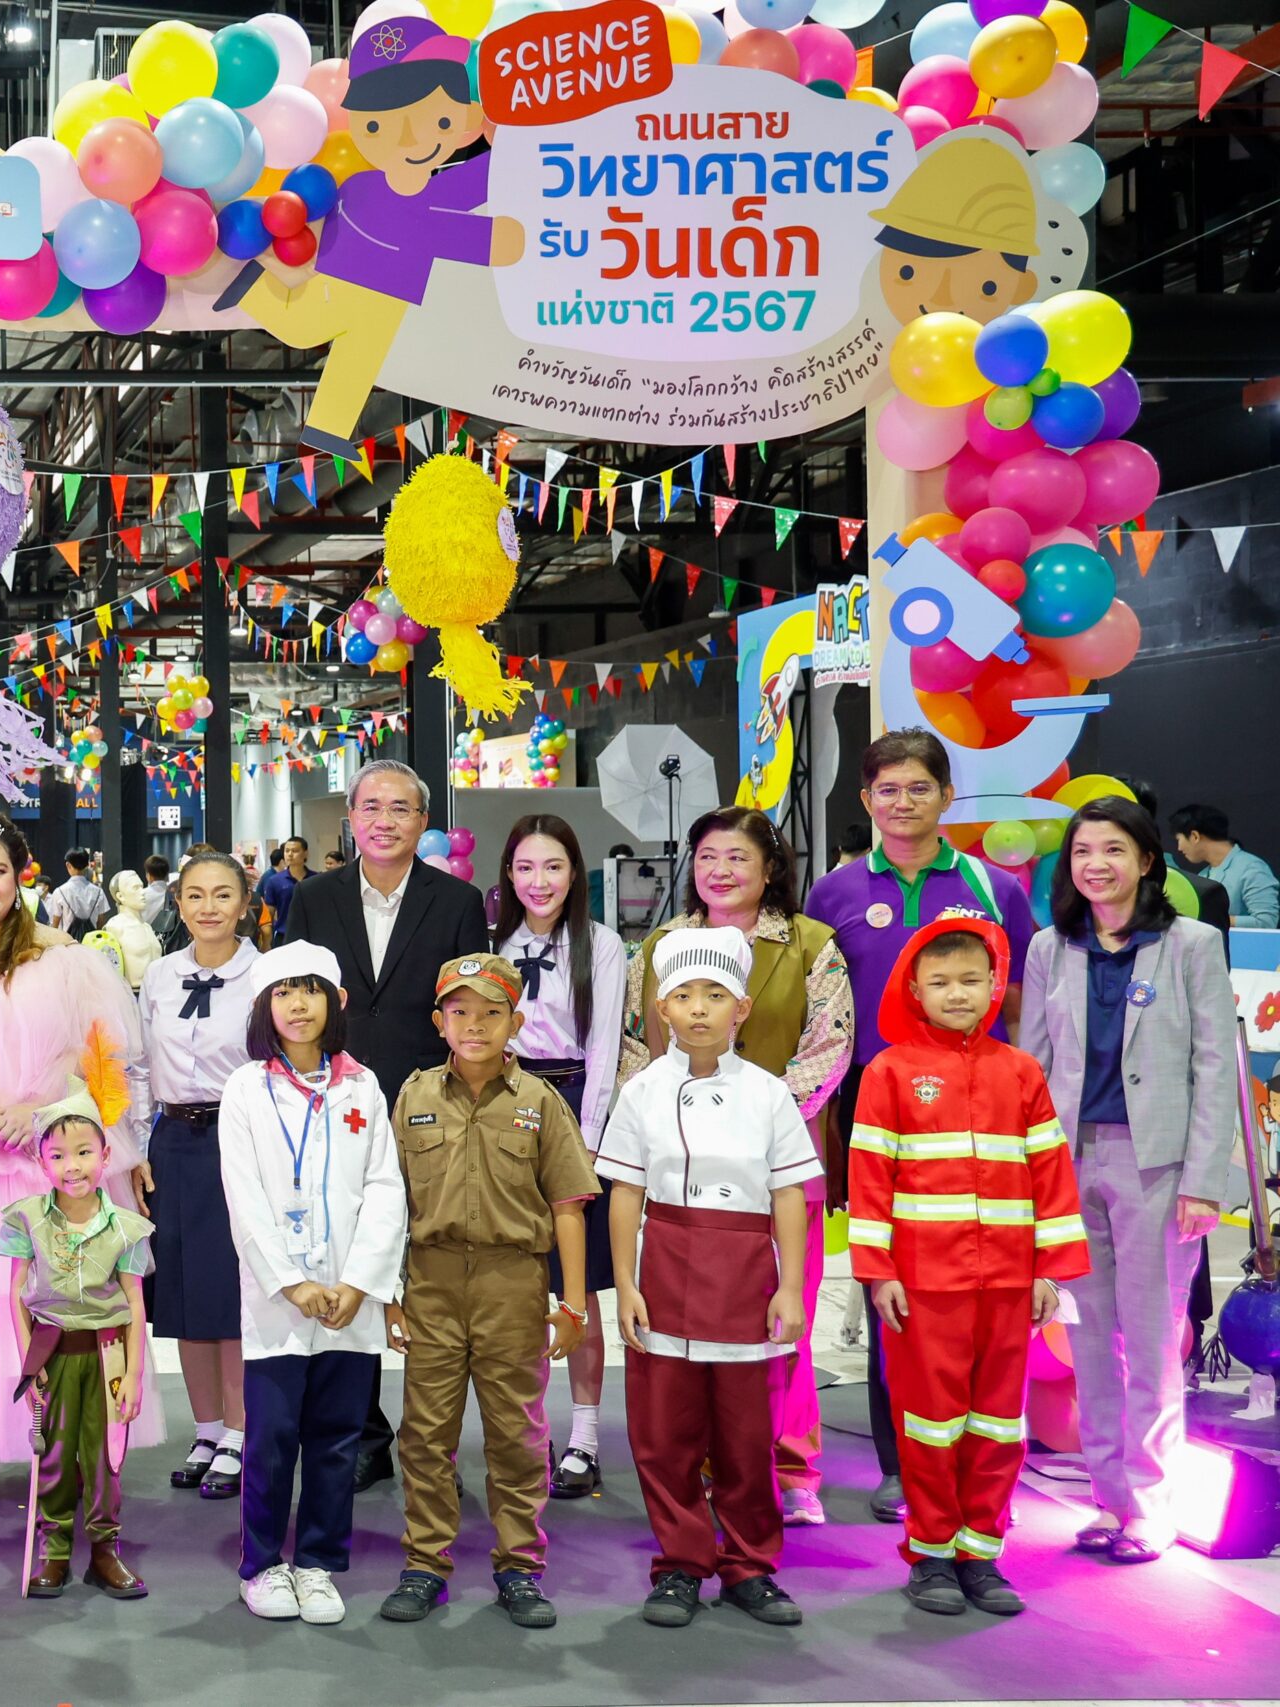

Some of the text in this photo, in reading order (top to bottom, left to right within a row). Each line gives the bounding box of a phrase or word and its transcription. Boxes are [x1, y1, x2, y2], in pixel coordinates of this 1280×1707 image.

[495, 15, 651, 77] SCIENCE
[510, 53, 651, 112] AVENUE
[635, 111, 789, 141] ถนนสาย
[539, 130, 893, 198] วิทยาศาสตร์
[539, 196, 819, 280] รับ วันเด็ก
[536, 289, 816, 333] แห่งชาติ 2567
[518, 348, 632, 391] คำขวัญวันเด็ก
[768, 318, 876, 390] คิดสร้างสรรค์
[492, 384, 660, 425] เคารพความแตกต่าง
